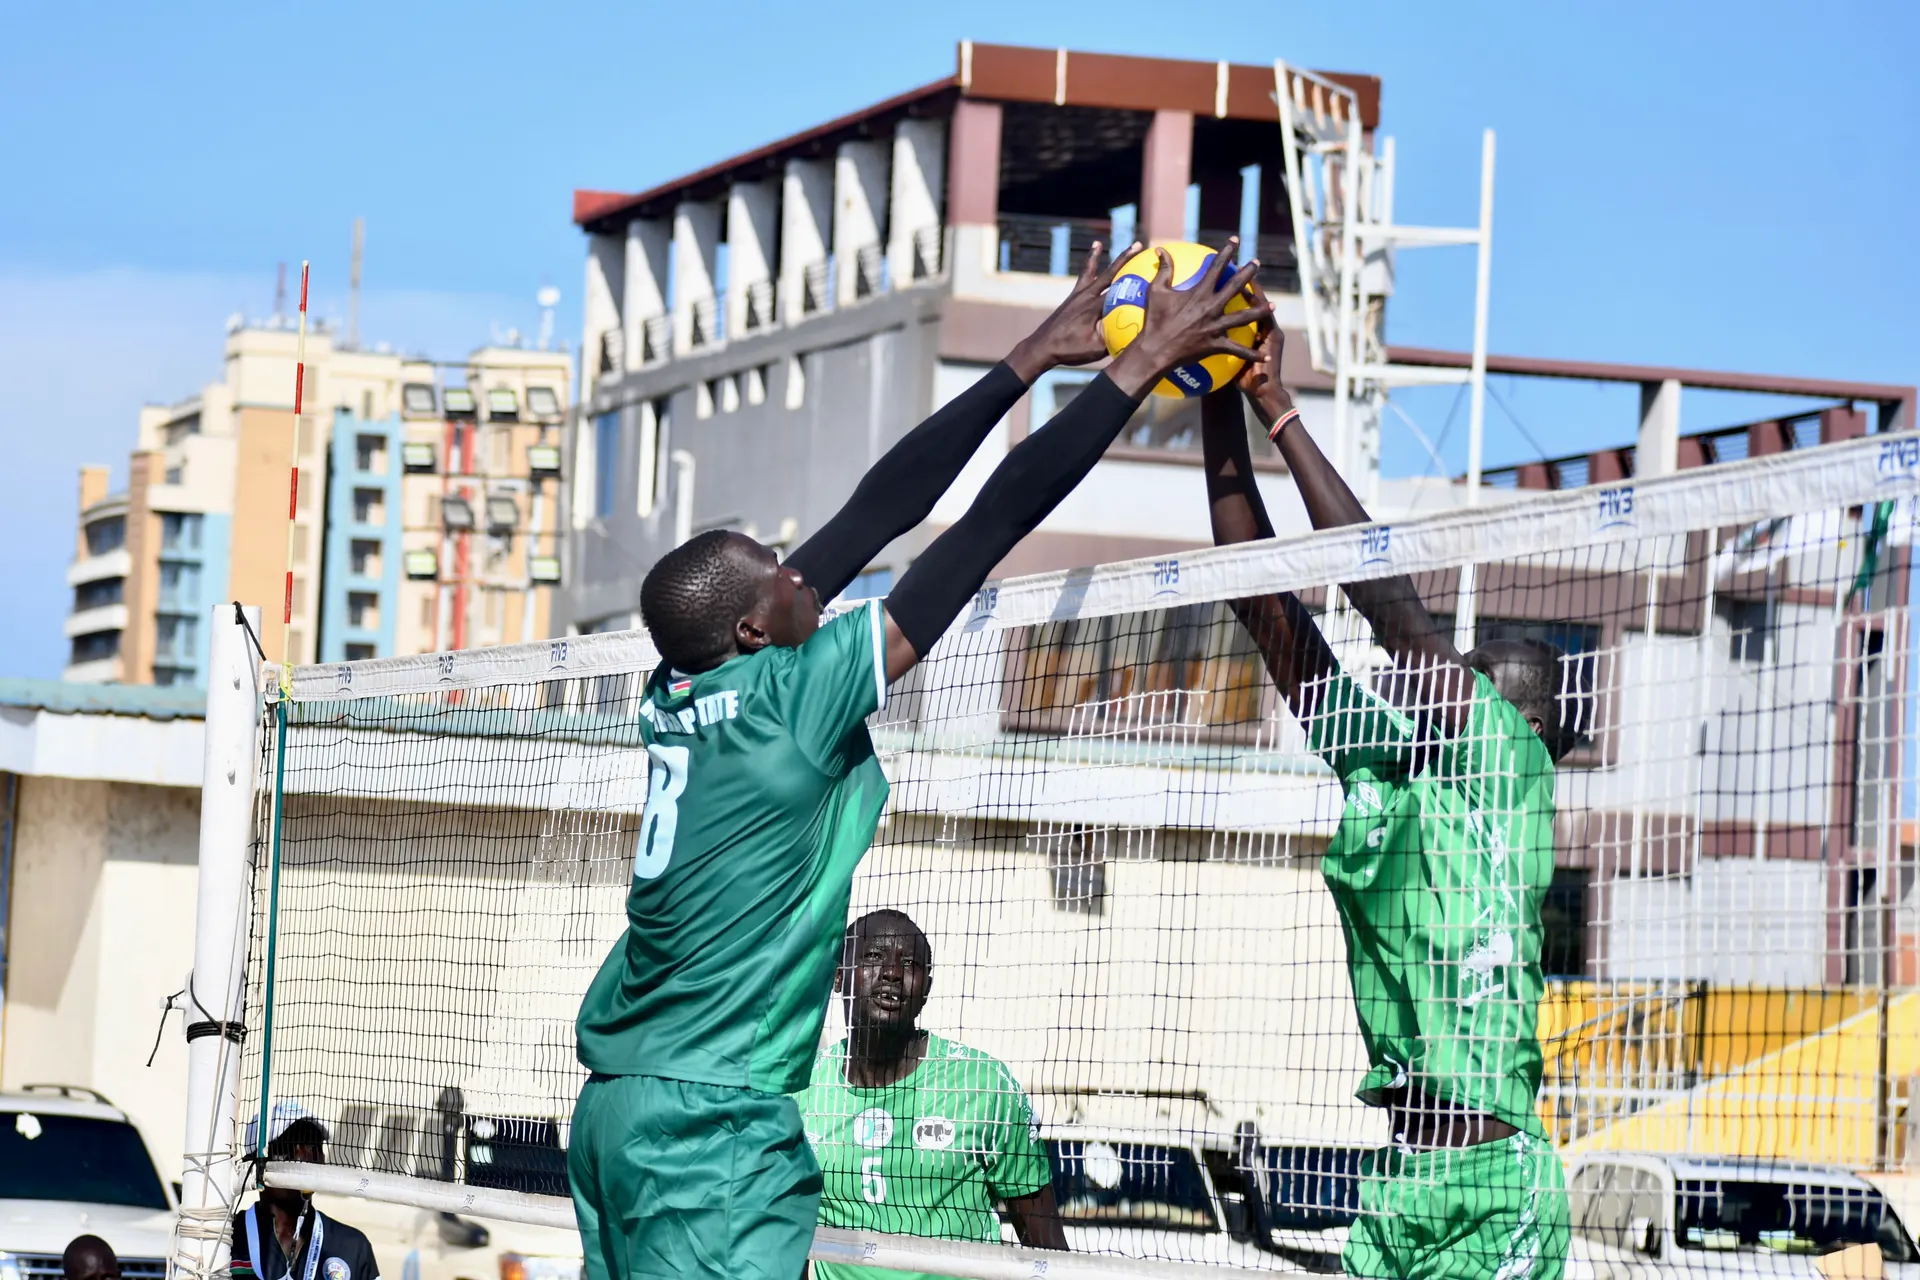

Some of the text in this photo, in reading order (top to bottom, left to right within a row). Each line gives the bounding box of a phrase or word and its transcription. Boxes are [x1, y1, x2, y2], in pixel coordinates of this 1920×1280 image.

[1173, 366, 1202, 390] KASA
[634, 744, 690, 879] 8
[861, 1157, 887, 1204] 5
